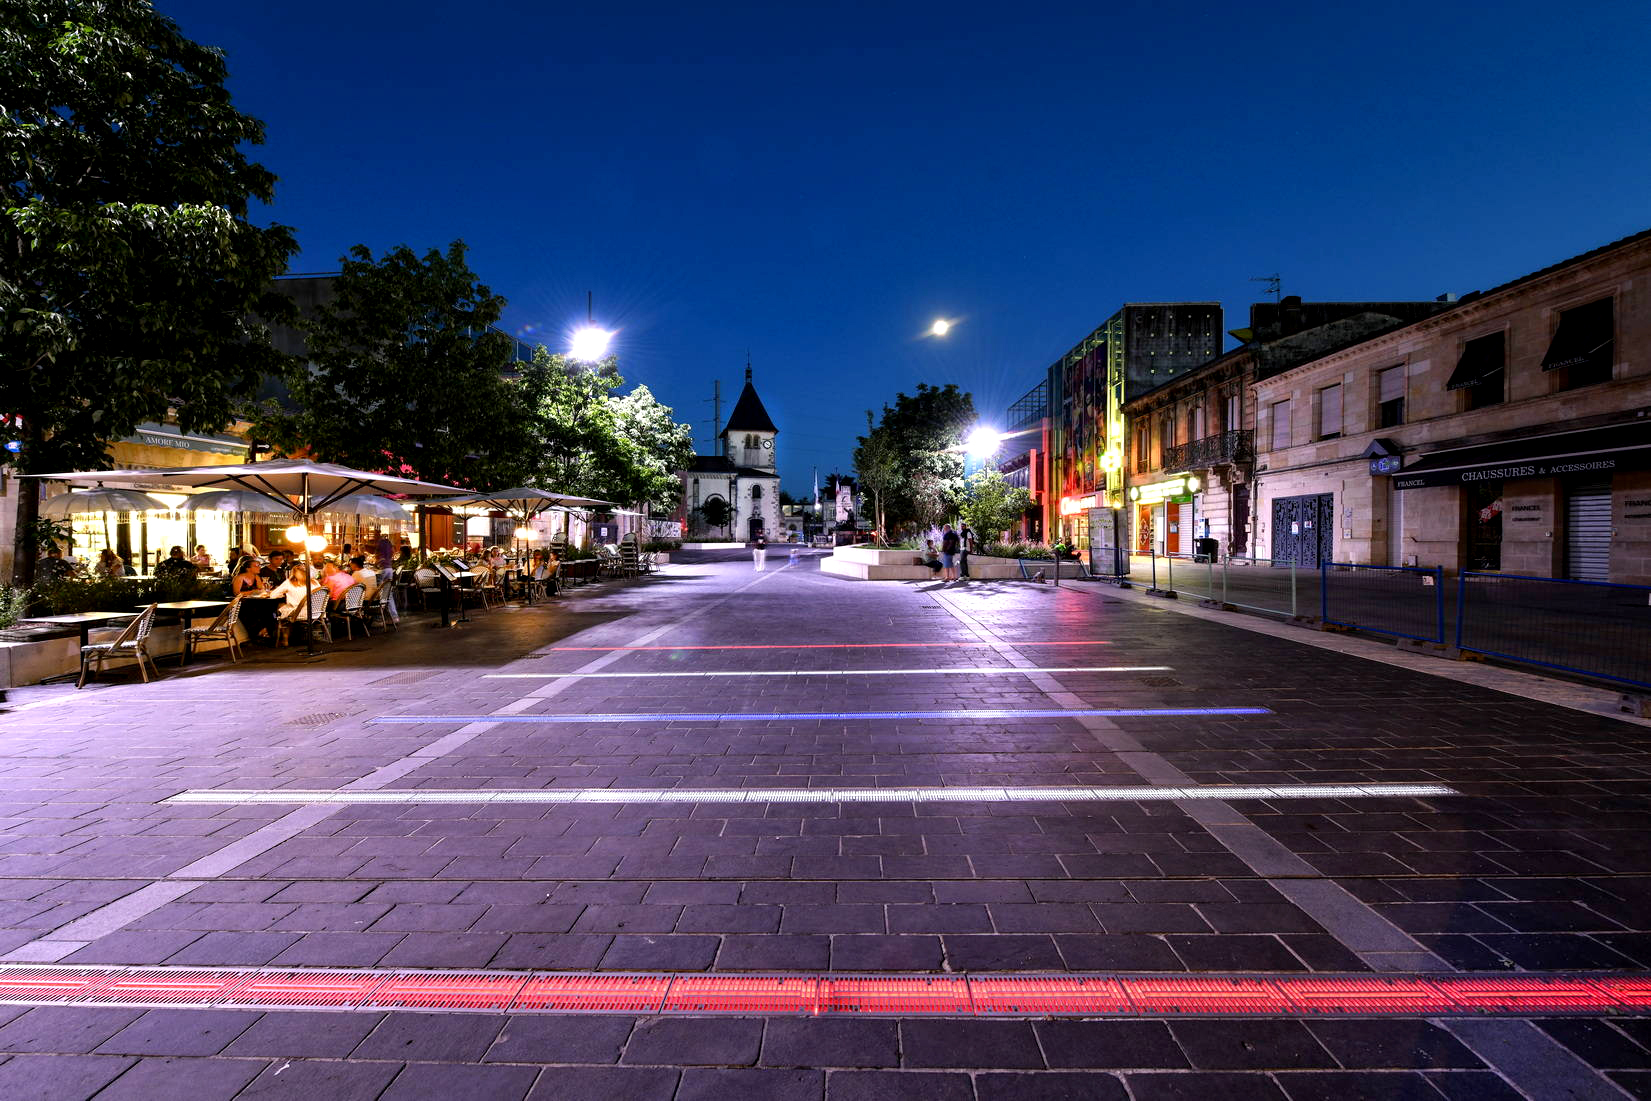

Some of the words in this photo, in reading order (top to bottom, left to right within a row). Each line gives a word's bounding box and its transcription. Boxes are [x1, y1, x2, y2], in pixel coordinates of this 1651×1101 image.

[146, 437, 173, 446] AMORE
[175, 440, 190, 448] MIO
[1462, 466, 1535, 481] CHAUSSURES
[1550, 460, 1616, 473] ACCESSOIRES
[1397, 479, 1425, 488] FRANCEL
